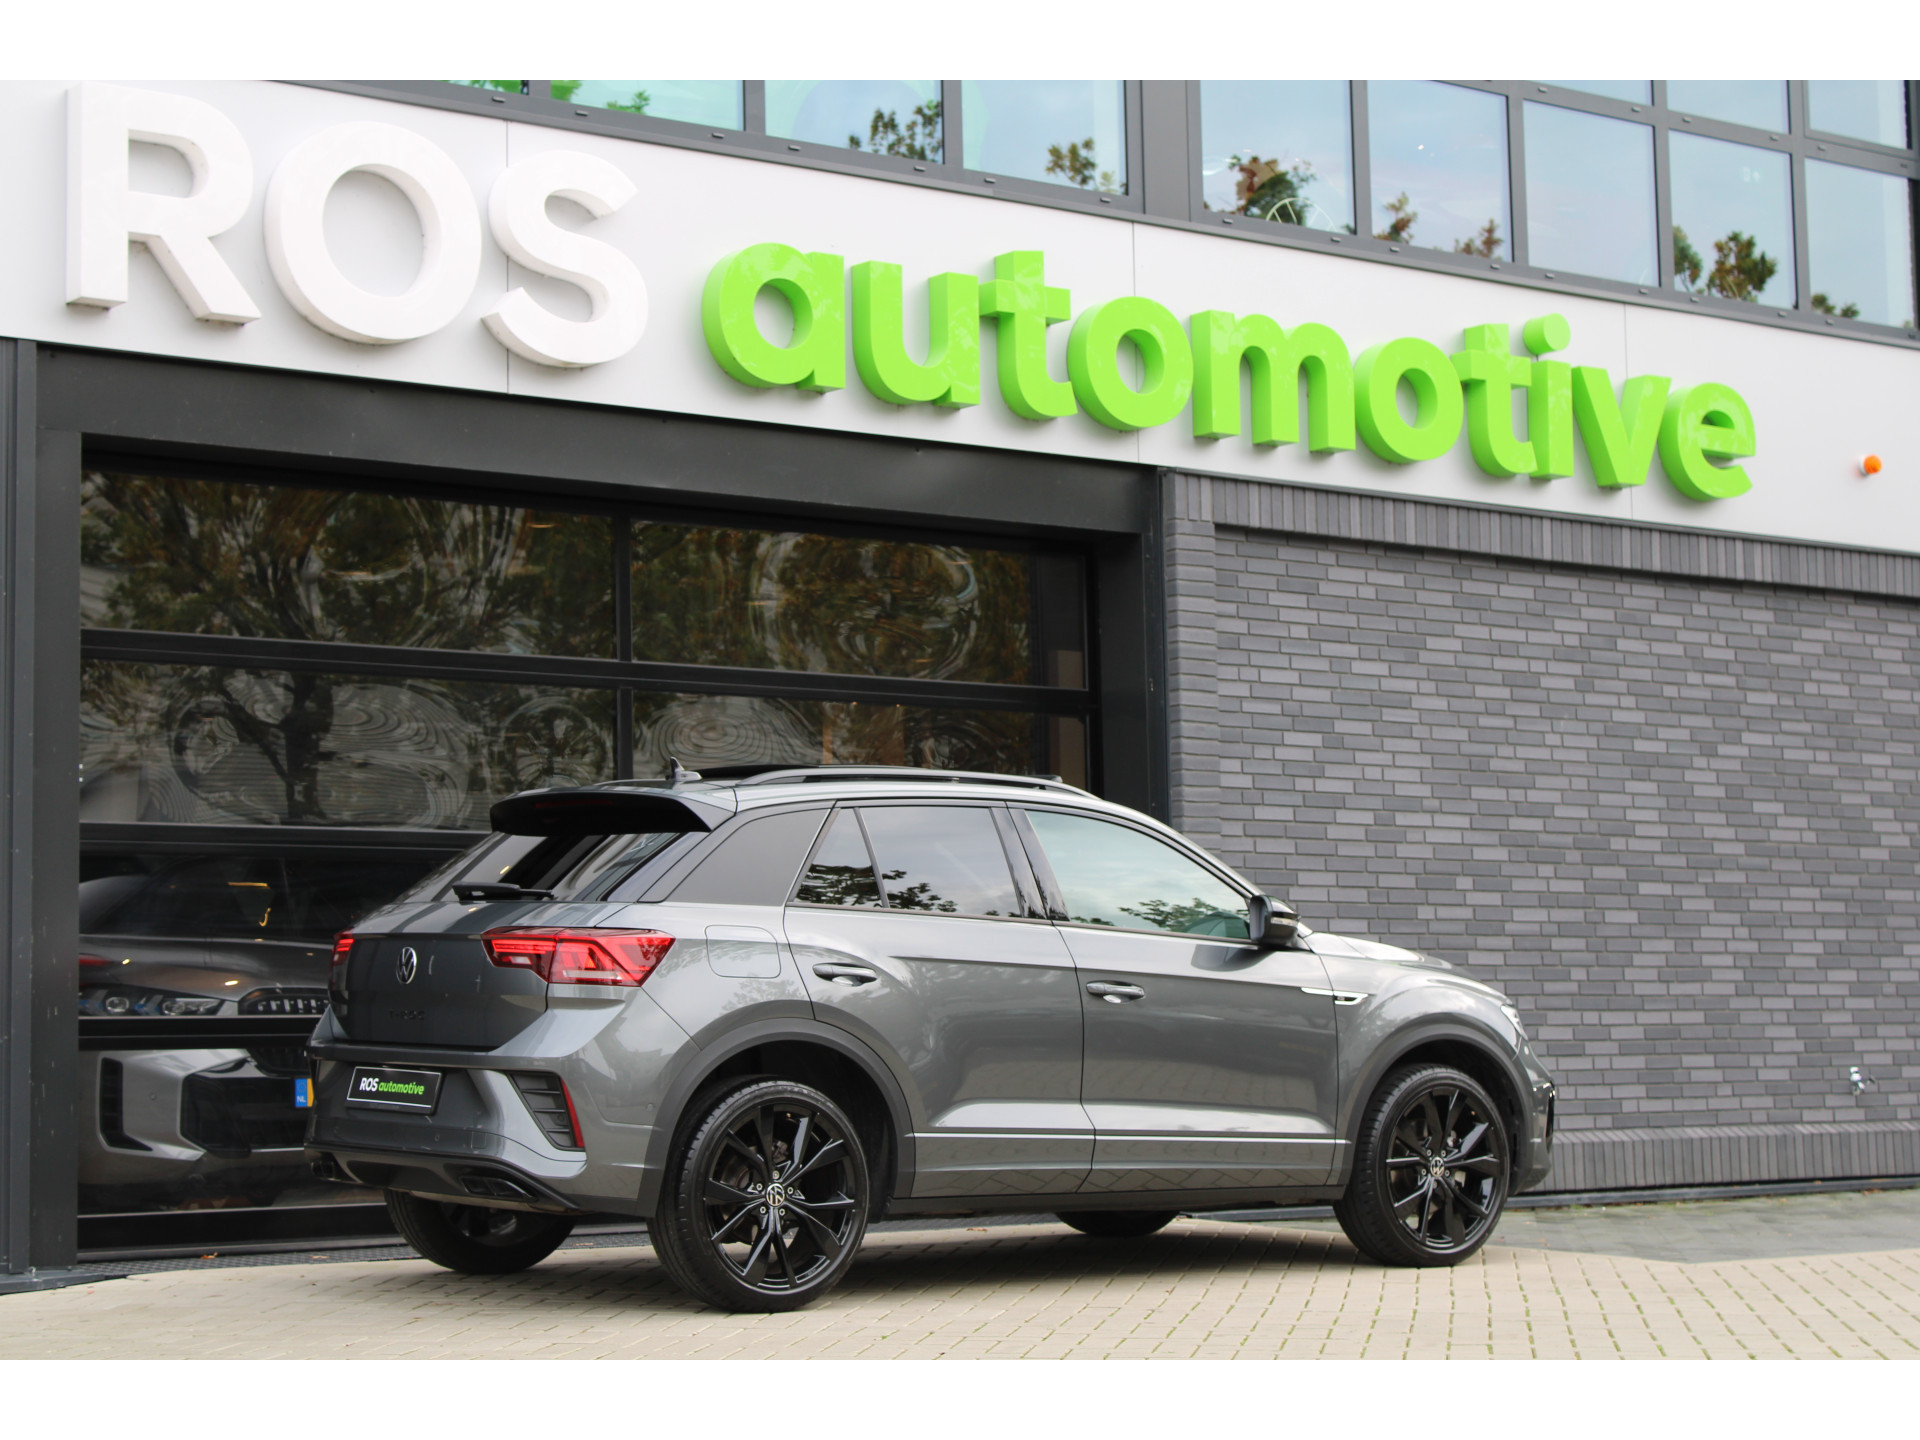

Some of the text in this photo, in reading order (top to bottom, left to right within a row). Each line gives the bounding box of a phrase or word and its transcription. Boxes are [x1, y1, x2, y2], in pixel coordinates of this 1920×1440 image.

[66, 82, 1756, 501] ROS automotive
[359, 1077, 425, 1095] ROS automotive
[296, 1095, 307, 1103] NL
